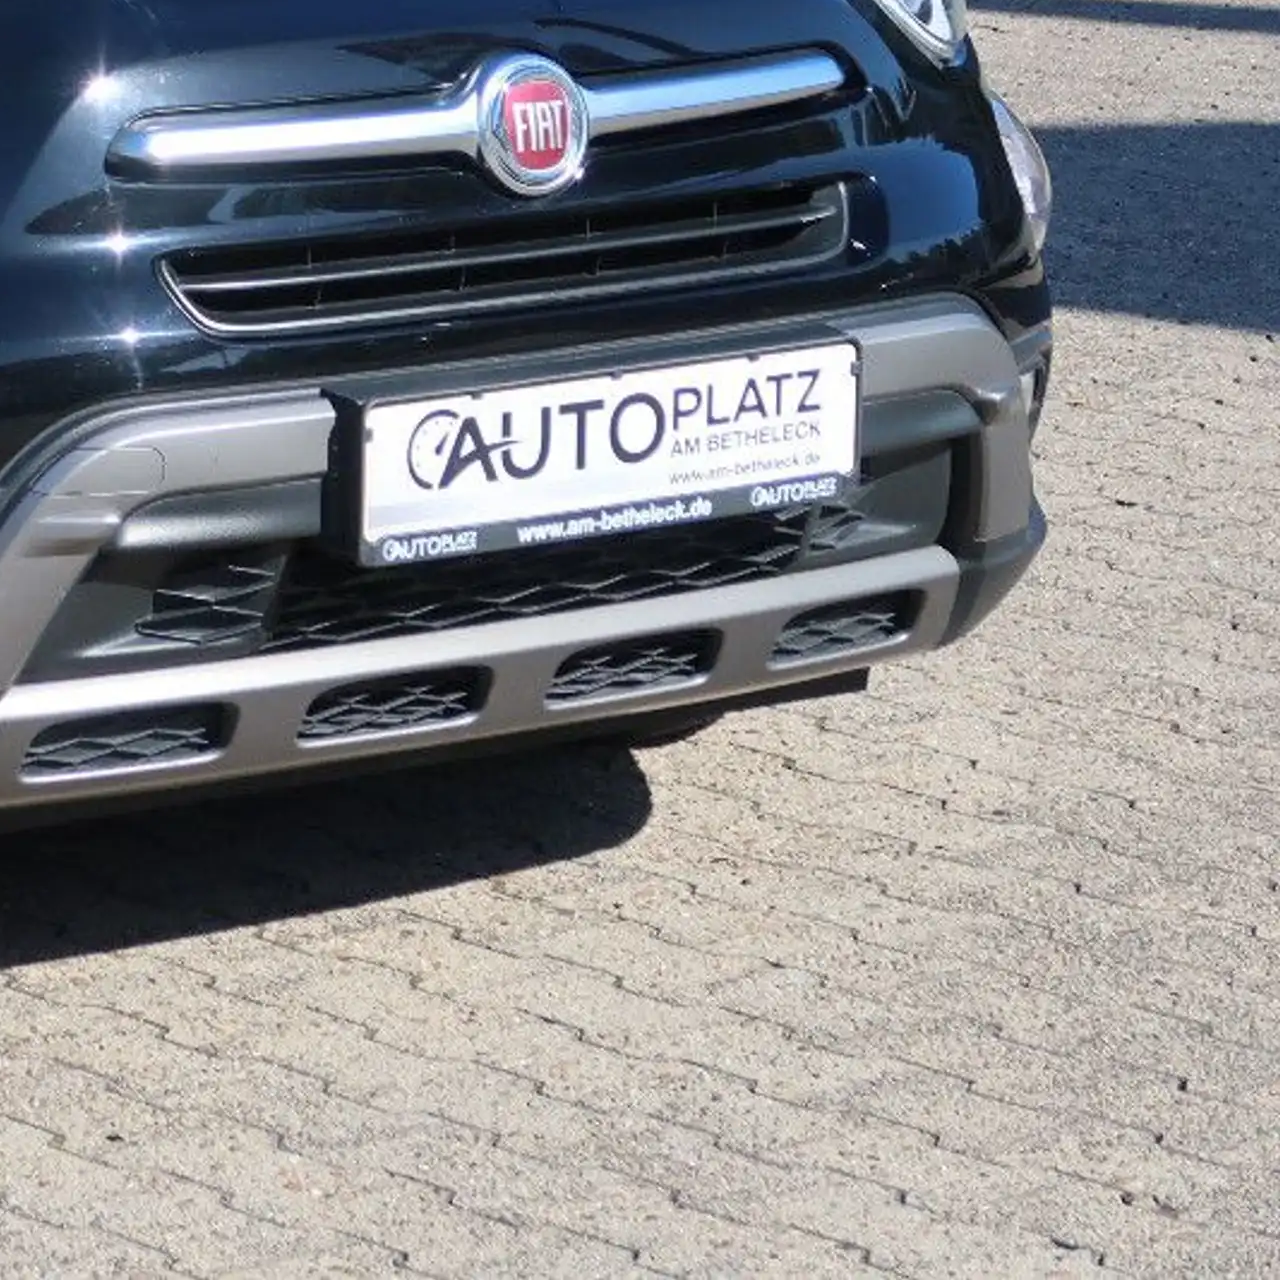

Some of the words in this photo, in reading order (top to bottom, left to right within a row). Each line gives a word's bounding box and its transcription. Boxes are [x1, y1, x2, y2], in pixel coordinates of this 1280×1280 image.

[511, 100, 564, 153] FIAT
[669, 437, 701, 458] AM
[706, 420, 822, 452] BETHELECK
[516, 497, 713, 545] www.am-betheleck.de
